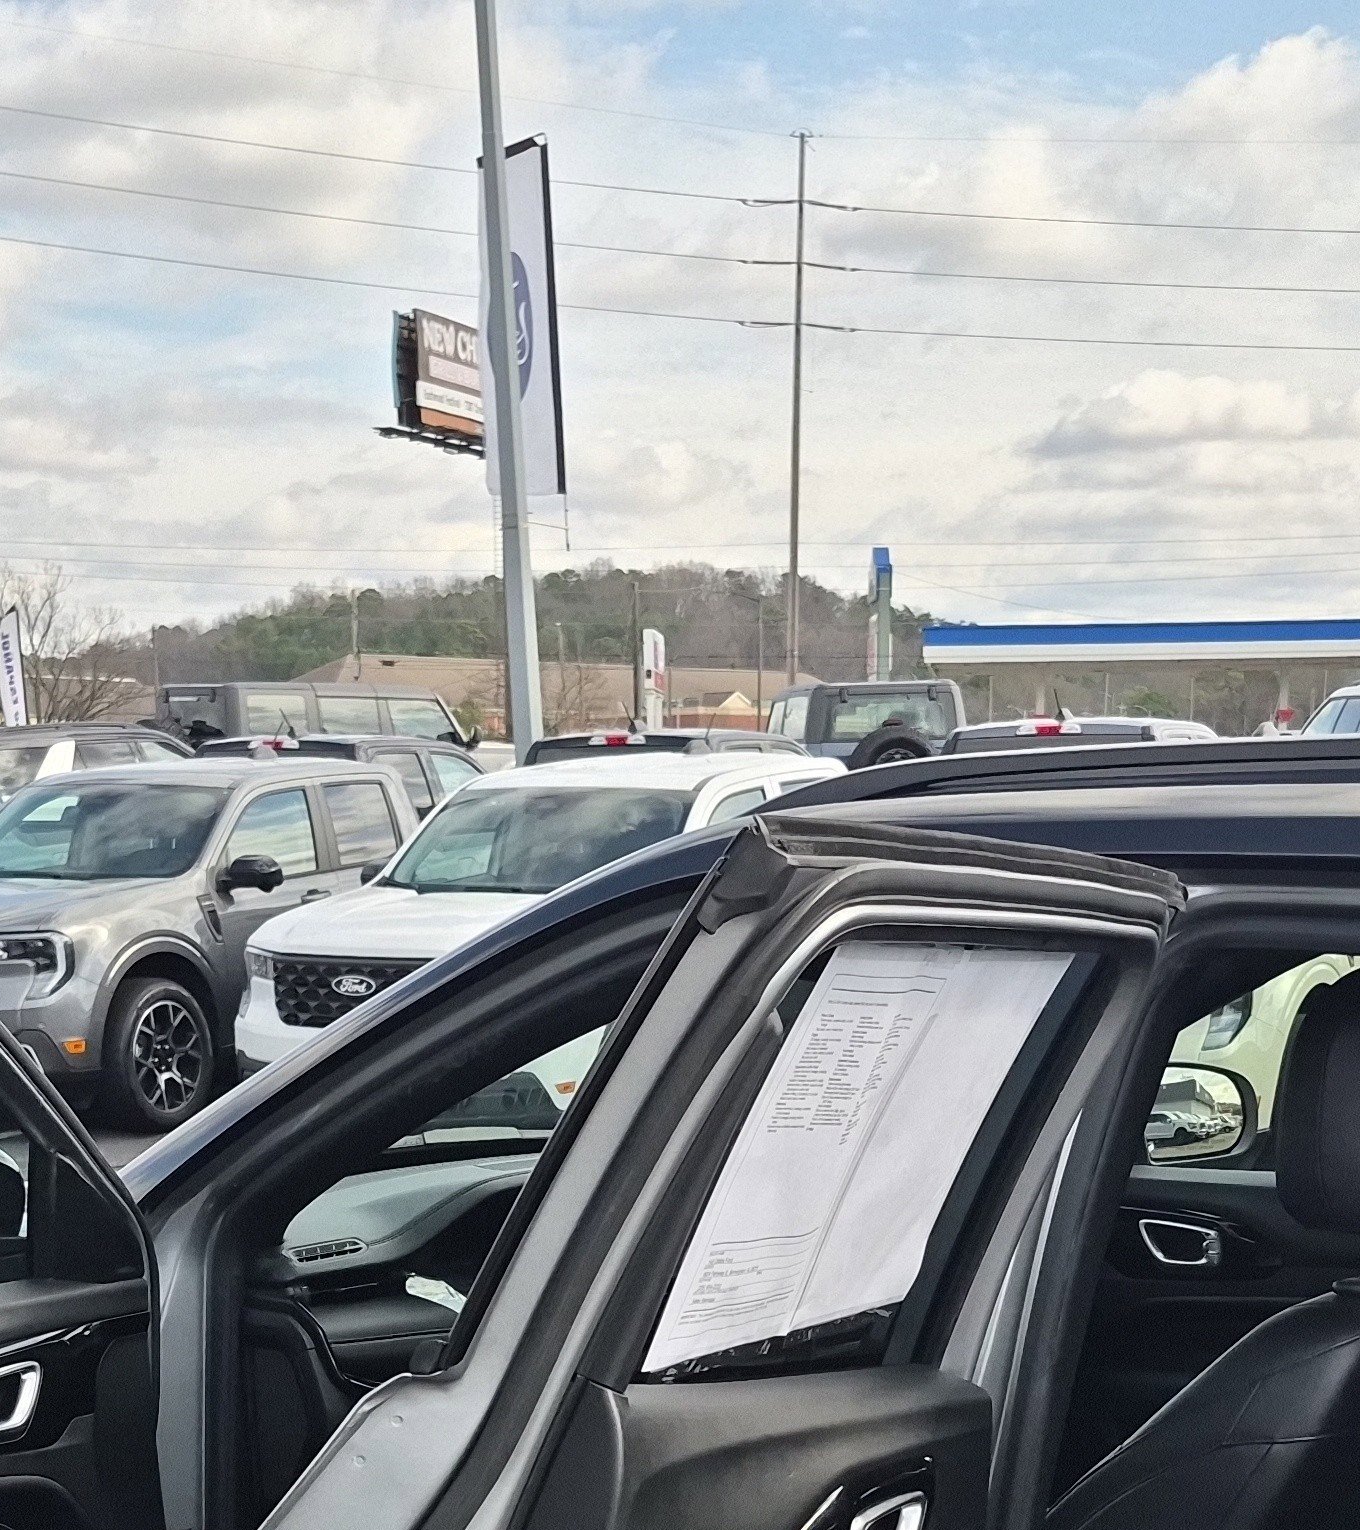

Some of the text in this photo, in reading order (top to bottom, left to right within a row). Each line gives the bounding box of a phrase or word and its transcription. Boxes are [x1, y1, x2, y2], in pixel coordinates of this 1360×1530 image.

[422, 316, 479, 366] NEW CH
[340, 978, 368, 993] Ford
